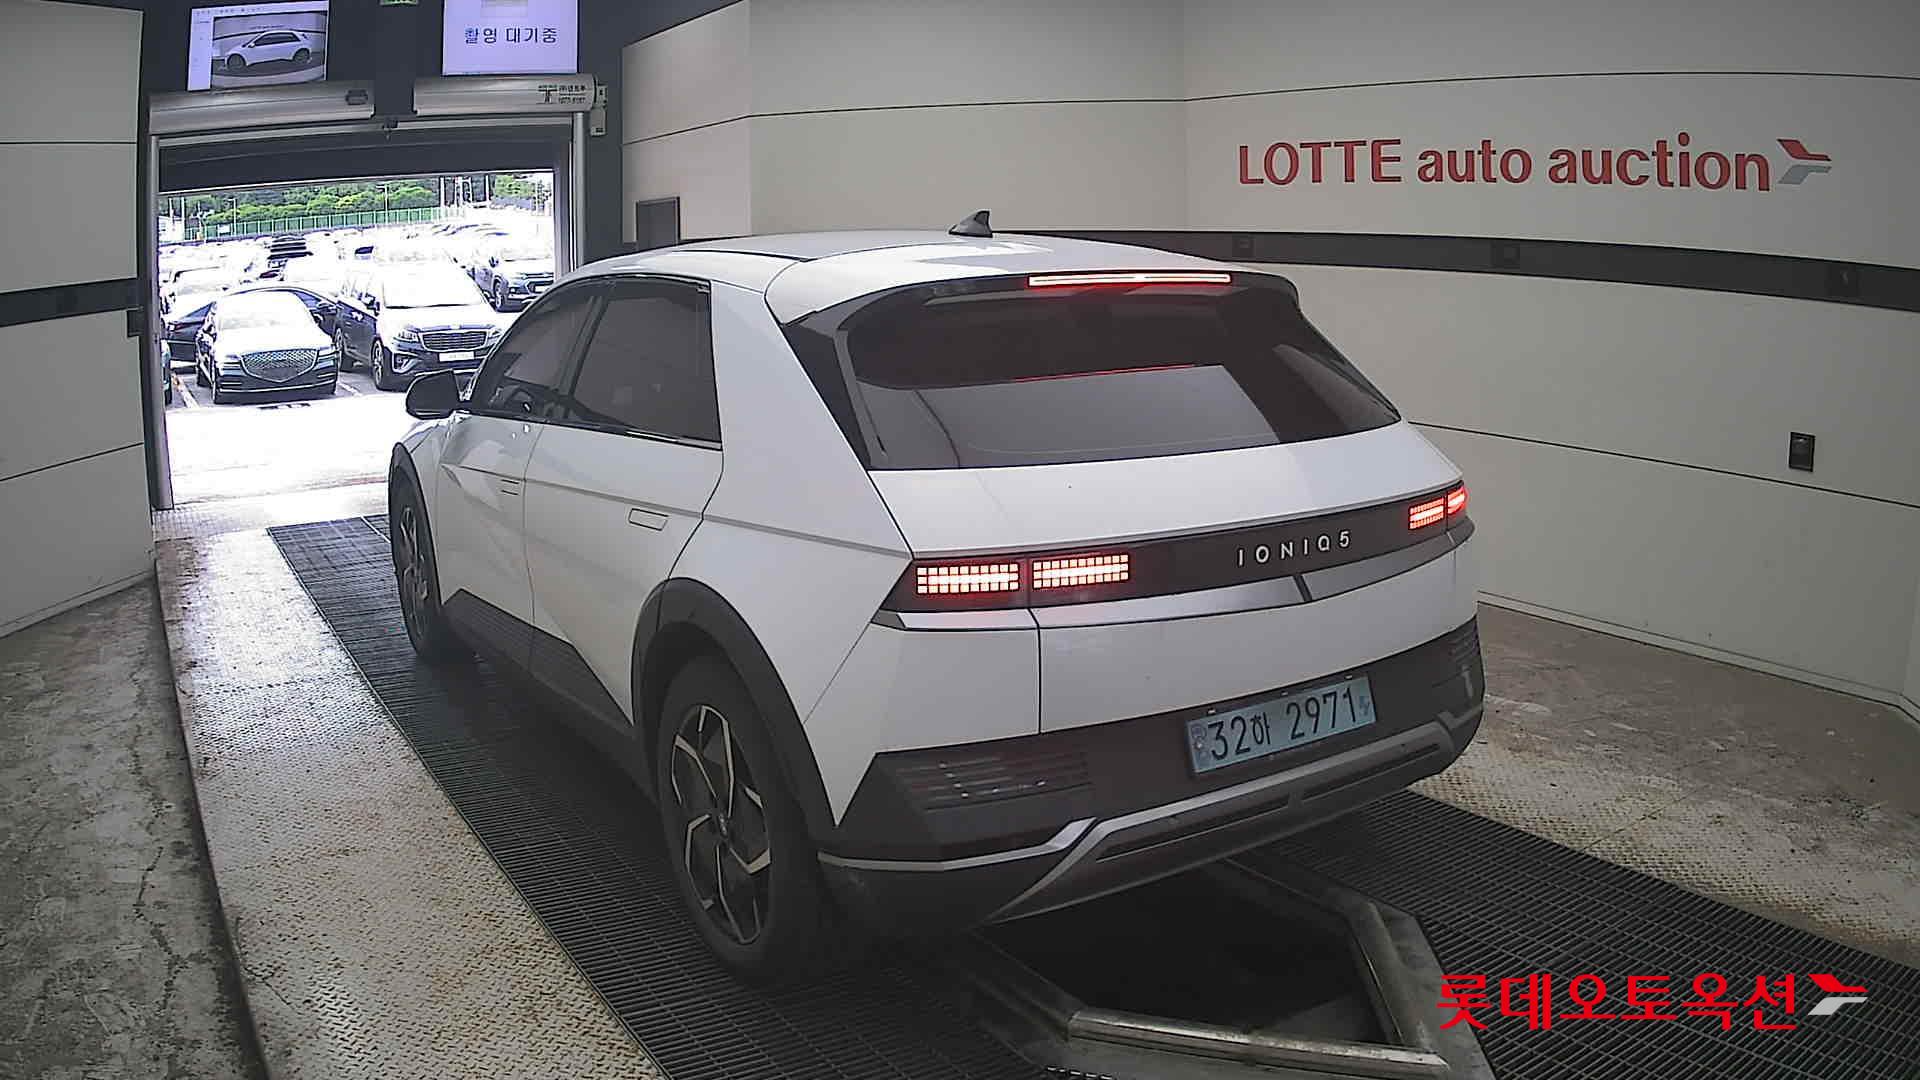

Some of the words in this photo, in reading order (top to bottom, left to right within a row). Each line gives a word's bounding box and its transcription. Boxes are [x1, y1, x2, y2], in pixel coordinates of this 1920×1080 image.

[505, 27, 558, 43] 대기중
[1239, 138, 1401, 185] LOTTE
[1417, 139, 1532, 184] auto
[1548, 132, 1771, 192] auction
[1286, 687, 1356, 740] 2971
